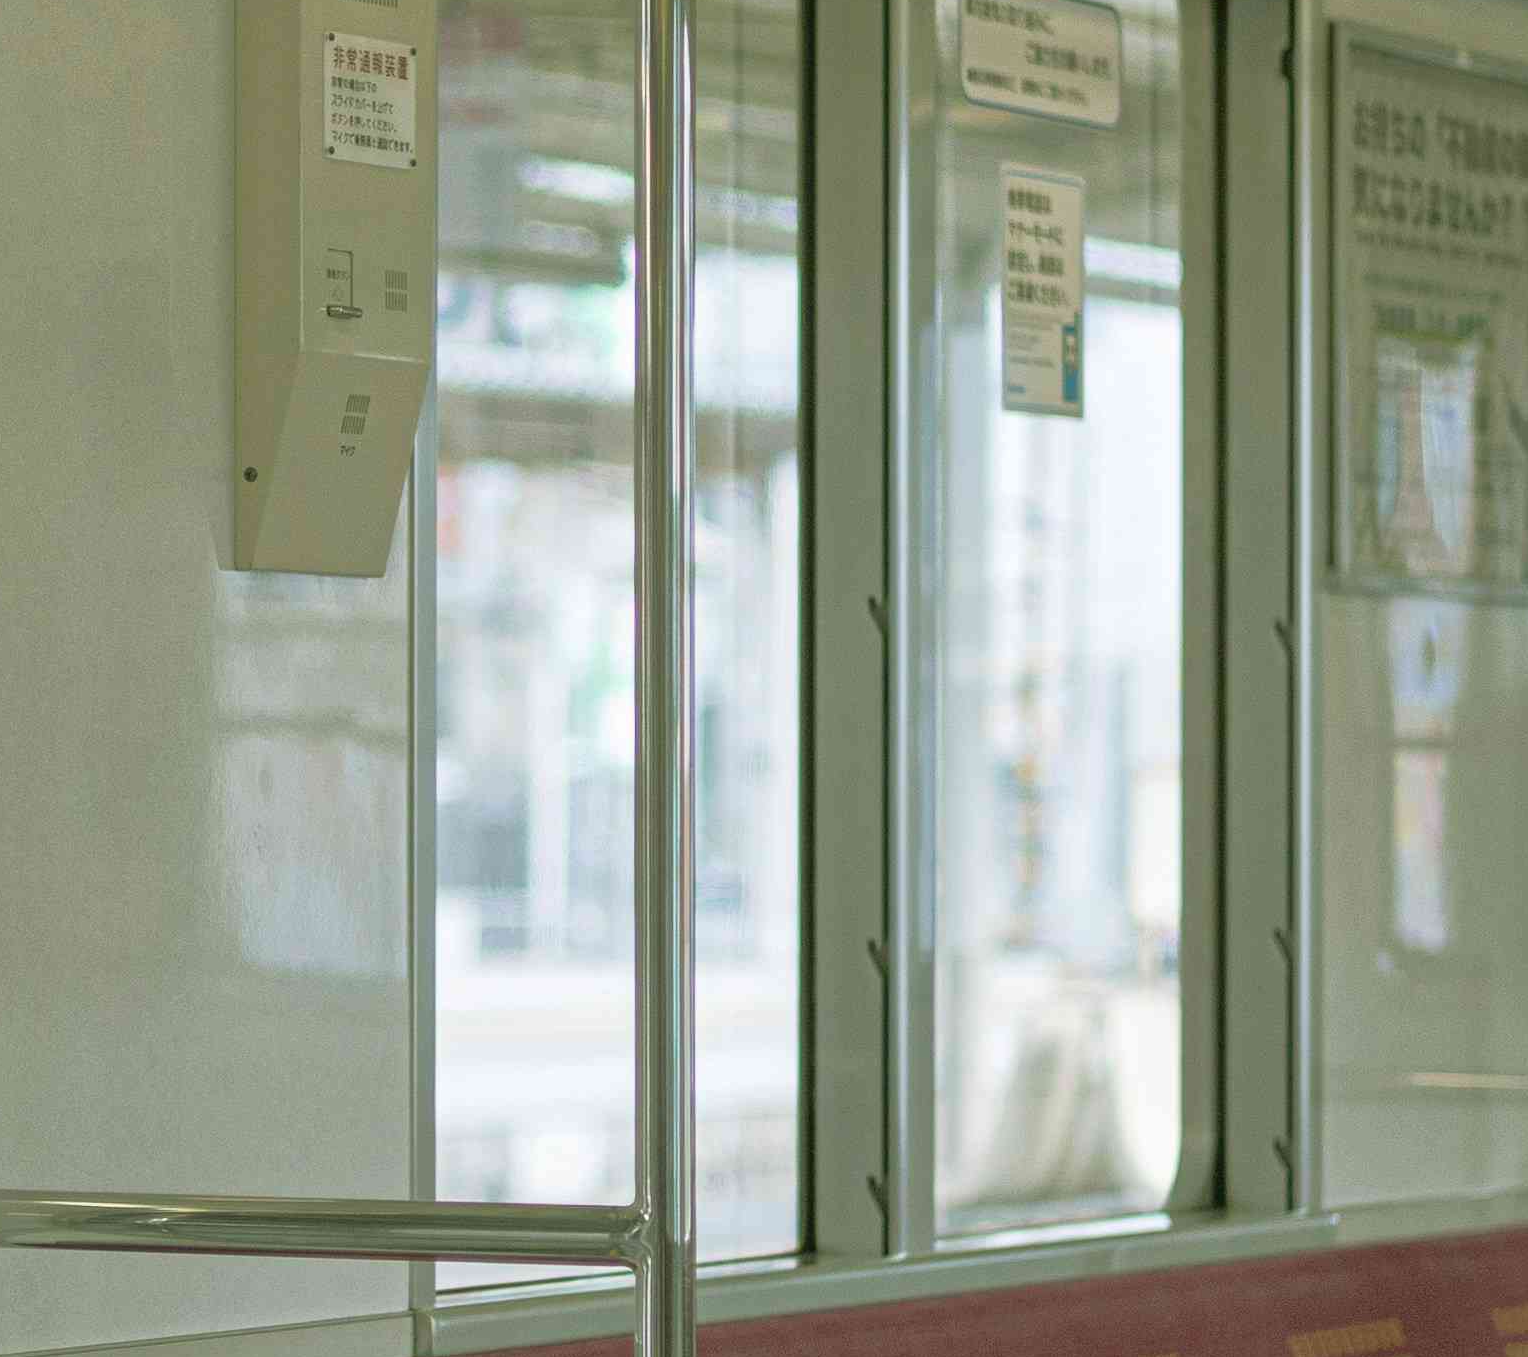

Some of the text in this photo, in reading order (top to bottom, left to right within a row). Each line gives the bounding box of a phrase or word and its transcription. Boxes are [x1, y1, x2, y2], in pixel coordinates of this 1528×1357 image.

[332, 45, 409, 81] 非常通報装置
